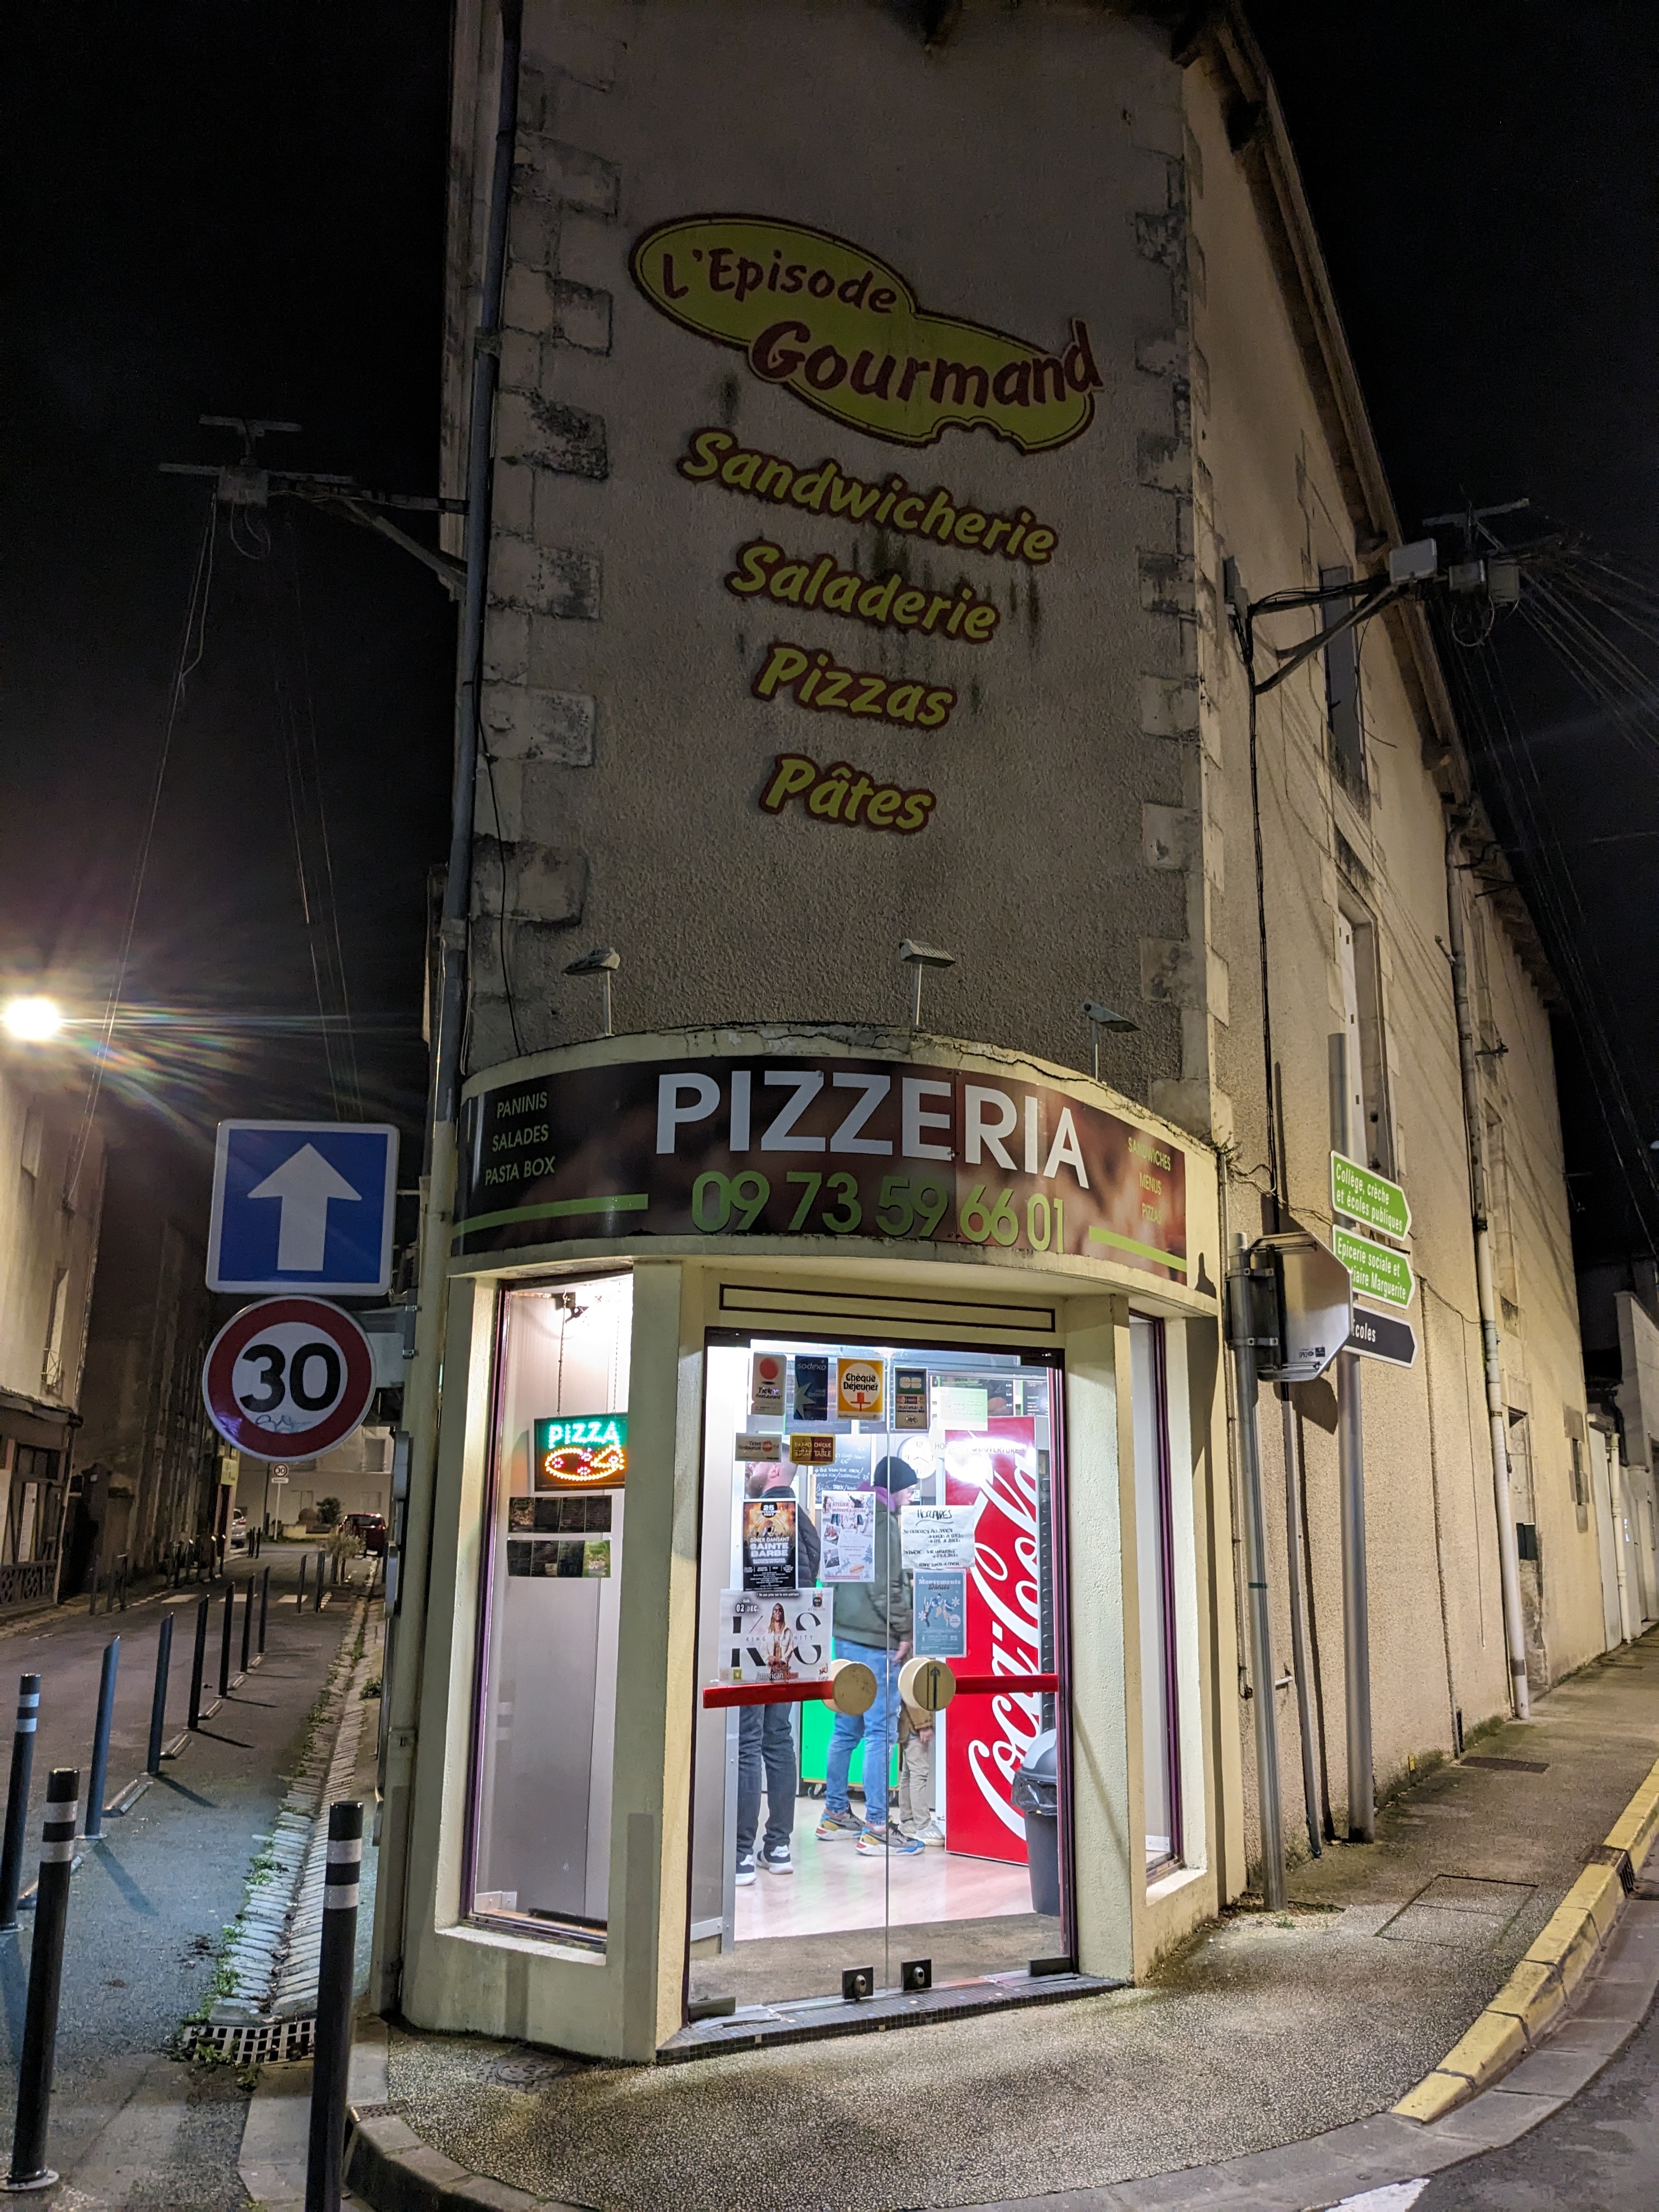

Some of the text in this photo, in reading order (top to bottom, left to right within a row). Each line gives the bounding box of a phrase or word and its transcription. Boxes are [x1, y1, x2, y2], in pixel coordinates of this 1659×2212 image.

[662, 247, 898, 314] L'Episode
[751, 317, 1104, 409] Gourmand
[680, 430, 1057, 563] Sandwicherie
[727, 544, 998, 641] Saladerie
[755, 646, 955, 728] Pizzas
[763, 756, 935, 832] Pâtes
[496, 1091, 548, 1119] PANINIS
[492, 1124, 549, 1152] SALADES
[656, 1070, 1089, 1189] PIZZERIA
[485, 1155, 556, 1186] PASTA BOX
[1128, 1137, 1171, 1171] SANDWICHES
[1139, 1172, 1161, 1195] MENUS
[1336, 1163, 1389, 1205] Collège, crèche
[692, 1171, 1064, 1254] 09 73 59 66 01
[1142, 1203, 1162, 1226] PIZZAS
[1336, 1189, 1402, 1232] et écoles publiques
[1338, 1237, 1401, 1277] Epicerie sociale et
[1351, 1265, 1406, 1300] tiaire Marguerite
[1352, 1318, 1376, 1342] coles
[239, 1342, 341, 1412] 30
[797, 1362, 826, 1370] sodexo
[845, 1373, 876, 1383] Chèque
[843, 1381, 879, 1392] Déjeuner
[549, 1421, 620, 1449] PIZZA
[751, 1549, 788, 1558] BARBE
[736, 1604, 745, 1612] 02
